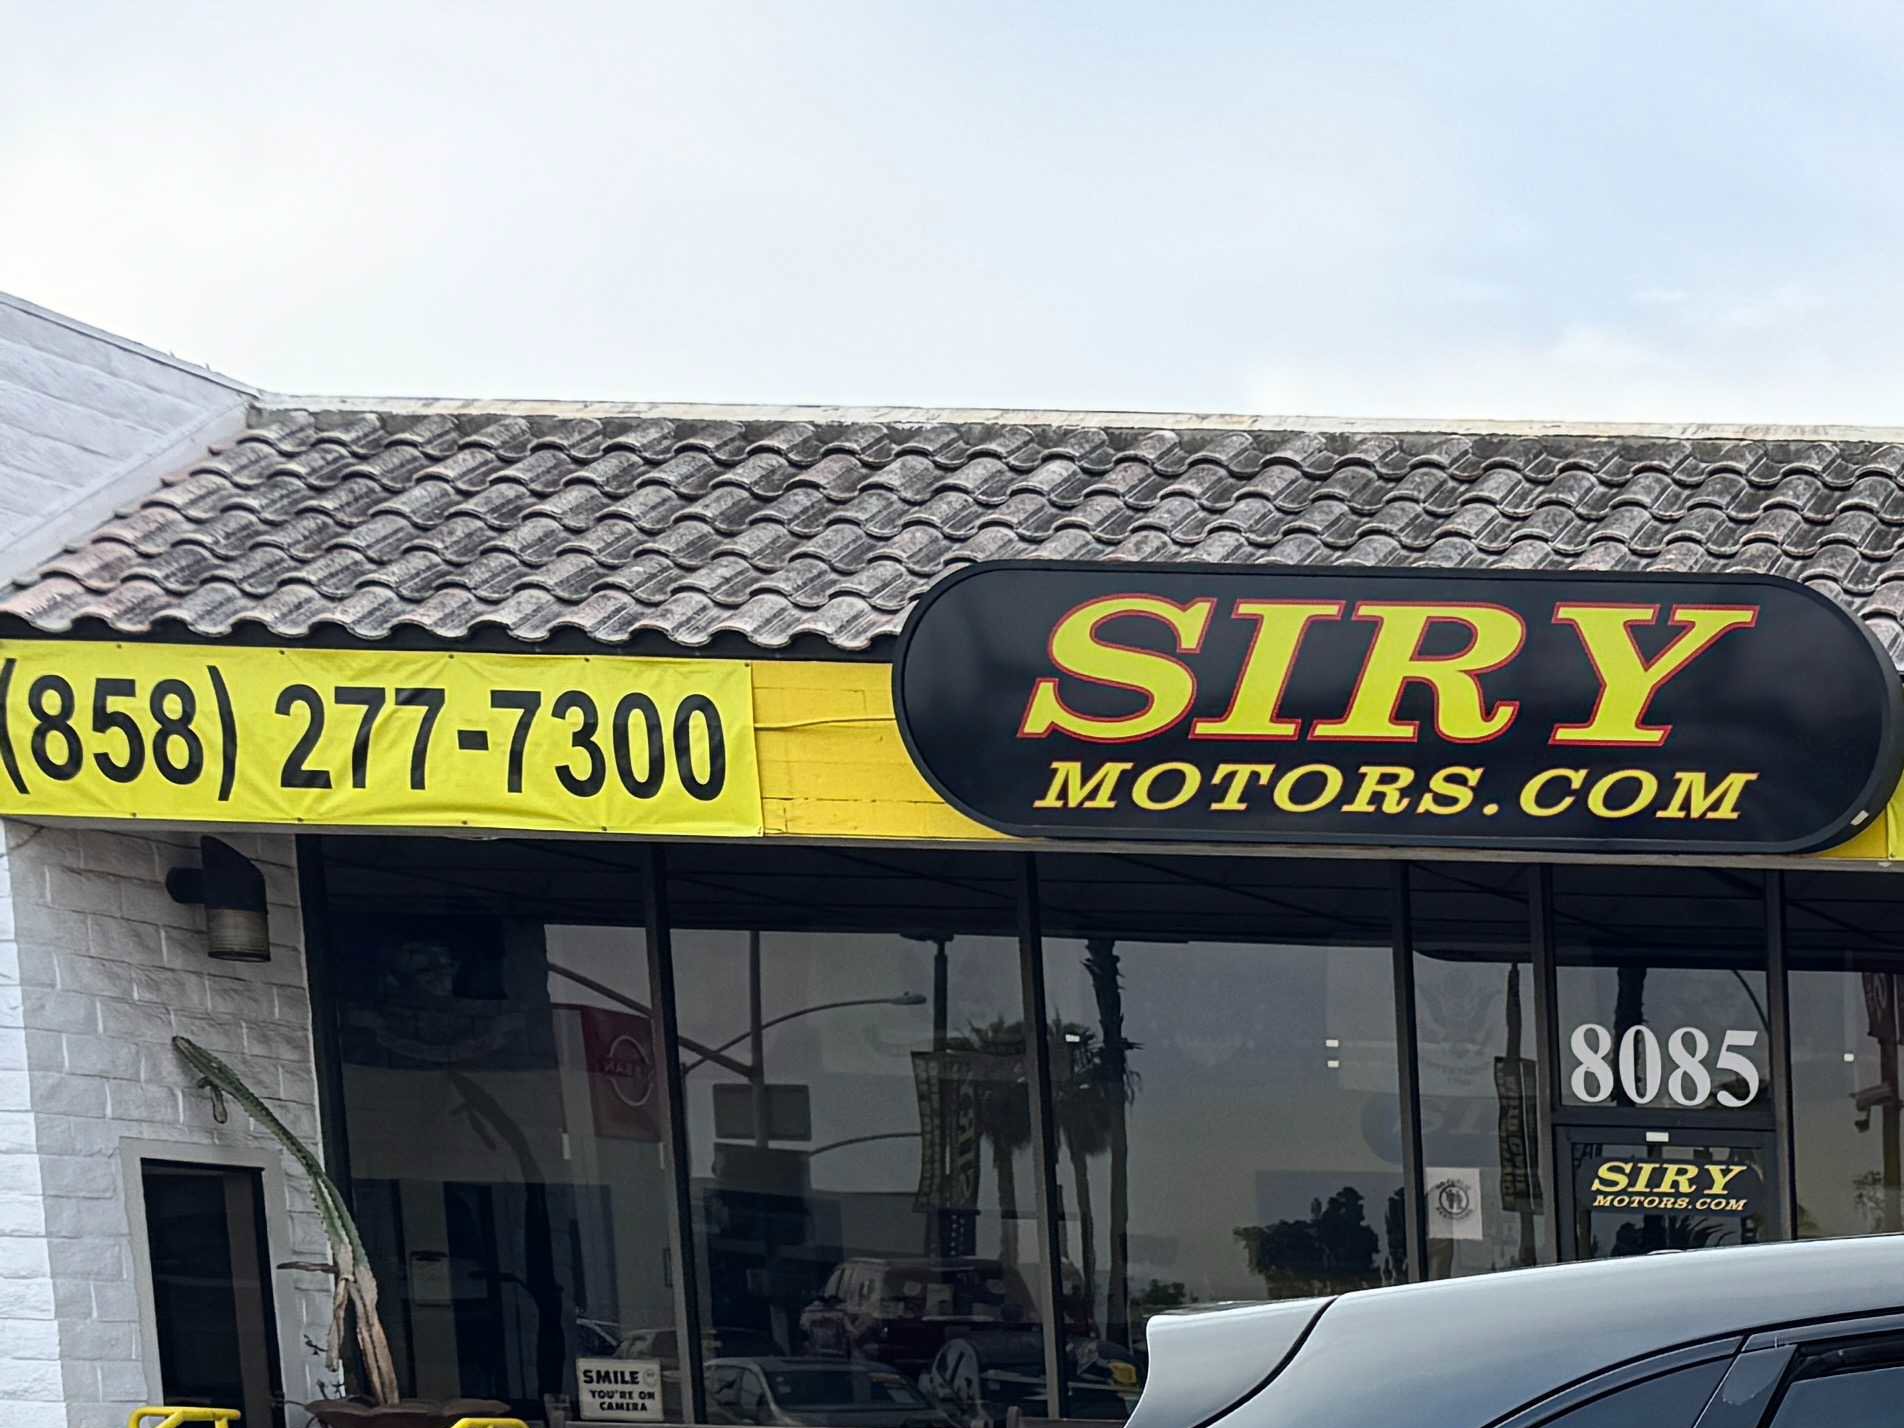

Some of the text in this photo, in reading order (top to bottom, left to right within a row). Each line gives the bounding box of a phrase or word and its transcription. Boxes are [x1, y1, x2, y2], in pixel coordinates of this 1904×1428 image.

[1017, 592, 1760, 747] SIRY
[0, 656, 727, 802] (858) 277-7300
[1033, 760, 1759, 820] MOTORS.COM
[1570, 1023, 1760, 1108] 8085
[1591, 1160, 1748, 1196] SIRY
[1592, 1194, 1747, 1212] MOTORS.COM
[582, 1369, 640, 1385] SMILE
[639, 1390, 656, 1400] ON
